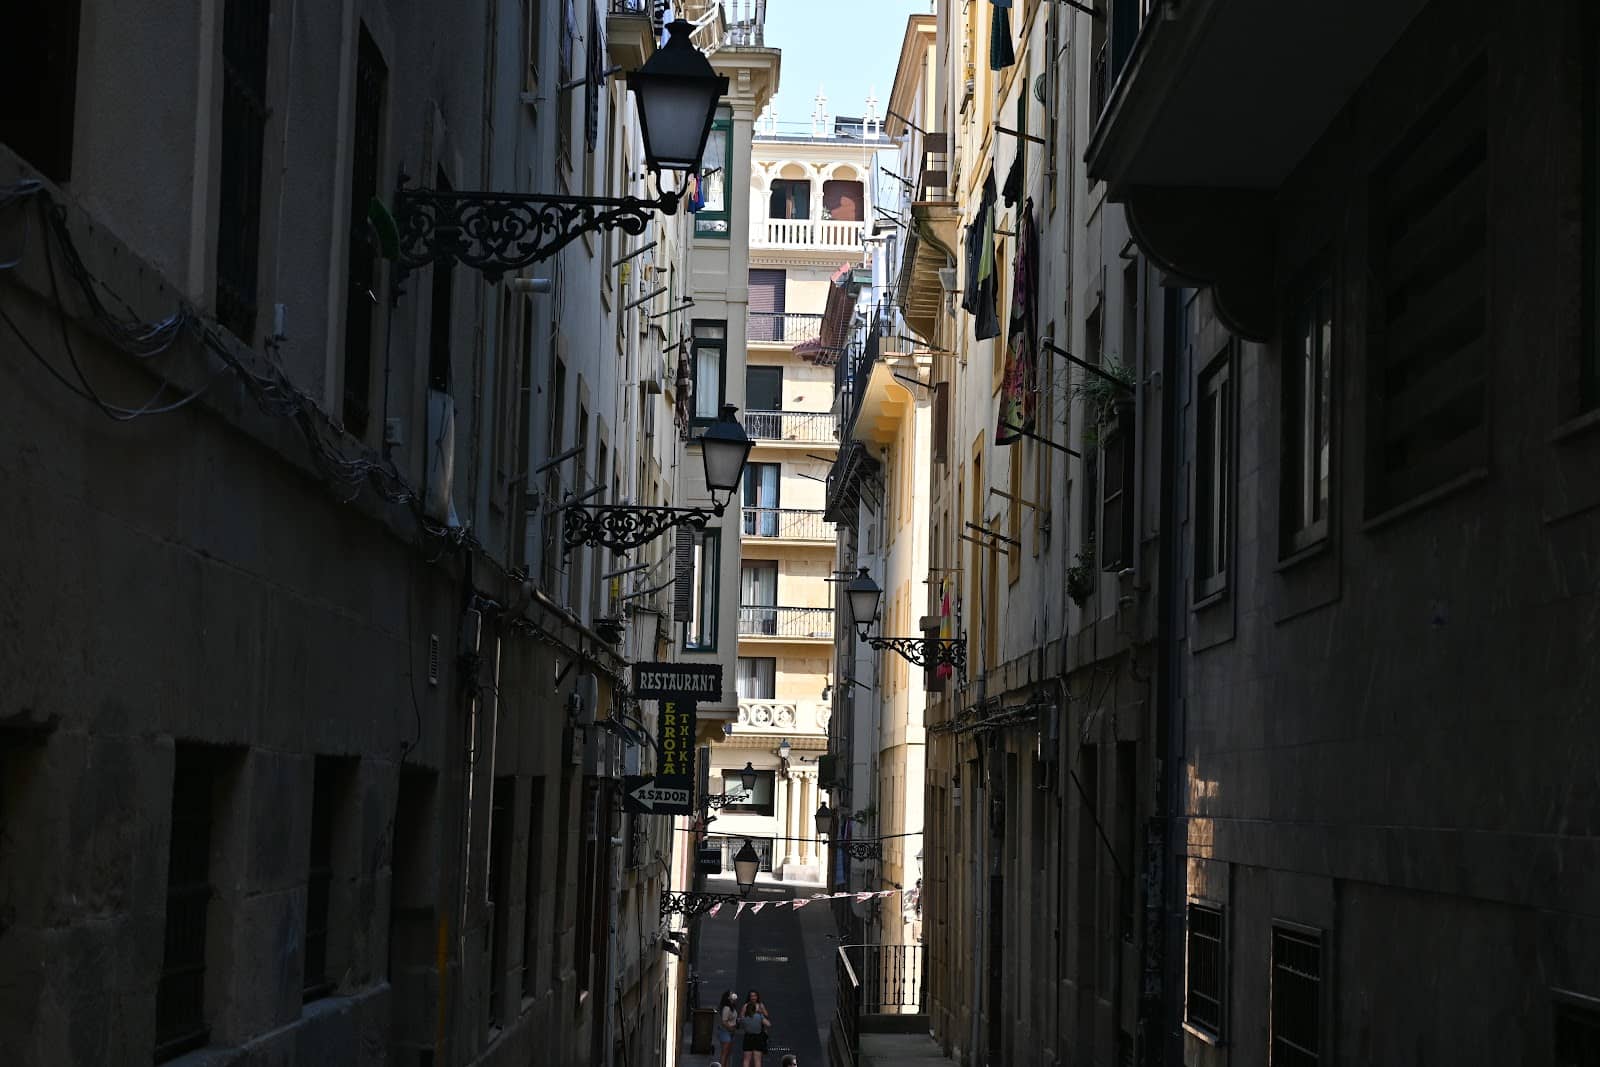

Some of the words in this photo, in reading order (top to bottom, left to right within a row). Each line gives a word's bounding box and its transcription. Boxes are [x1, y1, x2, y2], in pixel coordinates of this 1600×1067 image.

[640, 671, 715, 691] RESTAURANT
[663, 701, 677, 775] ERROTA
[638, 790, 686, 802] ASADOR
